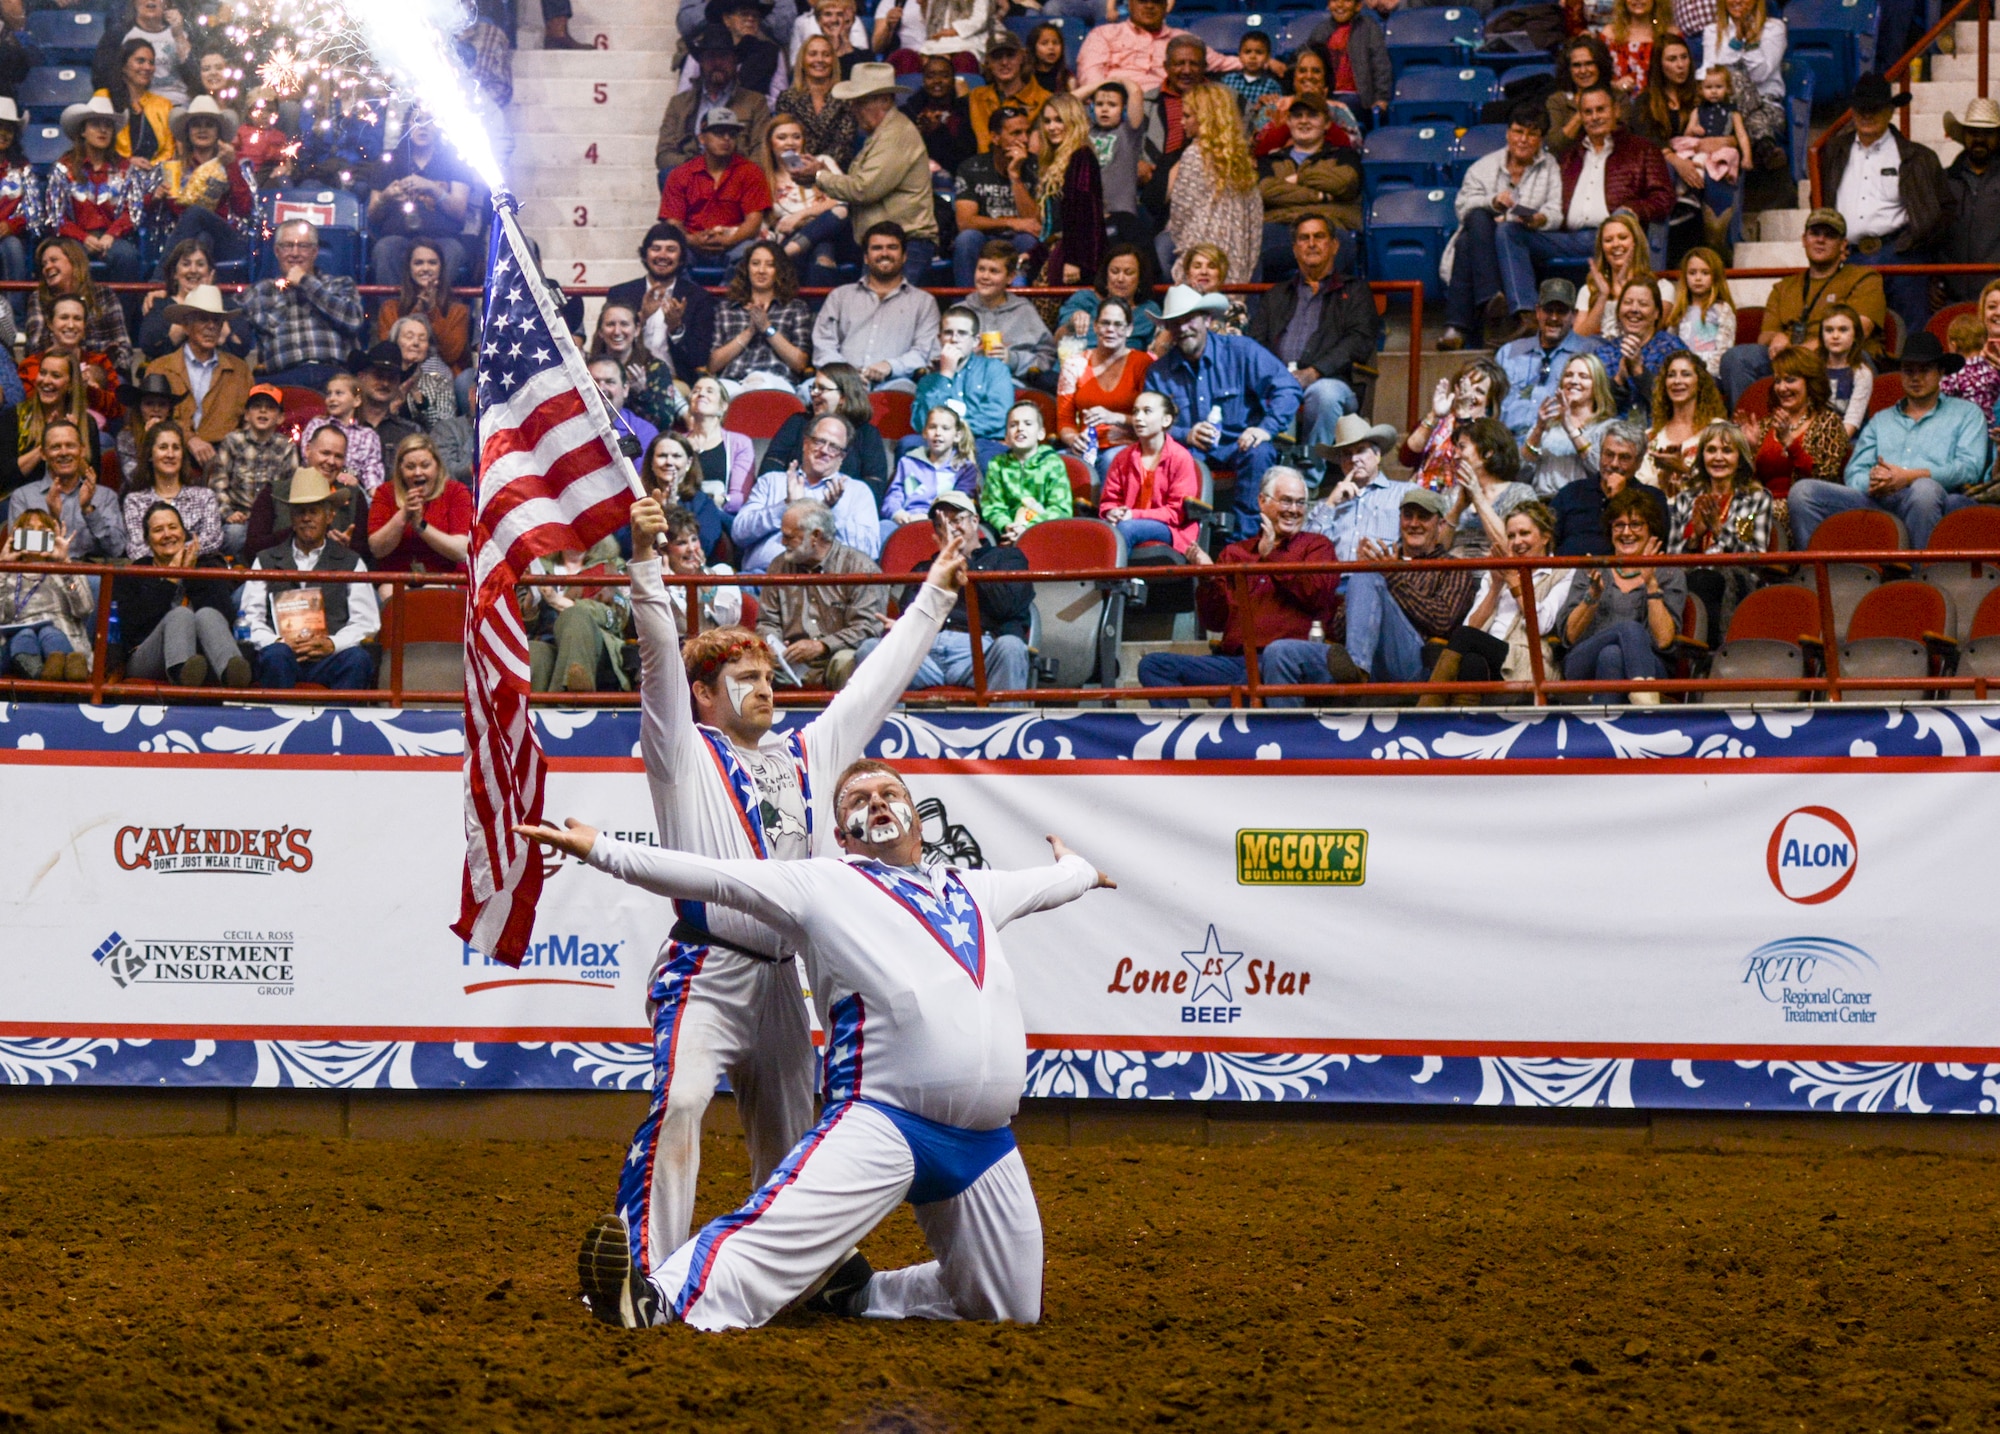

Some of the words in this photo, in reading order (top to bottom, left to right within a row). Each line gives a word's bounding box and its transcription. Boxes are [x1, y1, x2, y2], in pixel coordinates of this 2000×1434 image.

[593, 33, 609, 51] 6
[593, 82, 608, 105] 5
[584, 142, 599, 165] 4
[573, 205, 588, 228] 3
[572, 261, 587, 284] 2
[114, 823, 314, 873] CAVENDER'S
[1781, 838, 1849, 868] ALON
[180, 855, 202, 869] JUST
[205, 855, 230, 868] WEAR
[245, 858, 265, 871] LIVE
[1244, 869, 1304, 880] BUILDING
[1307, 870, 1354, 881] SUPPLY
[223, 931, 254, 941] CECIL
[268, 931, 294, 941] ROSS
[143, 944, 294, 962] INVESTMENT
[462, 934, 620, 967] FerMax
[154, 963, 294, 981] INSURANCE
[580, 969, 620, 979] cotton
[1107, 957, 1188, 994] Lone
[1245, 959, 1311, 996] Star
[1742, 956, 1817, 1000] RCTC
[257, 986, 295, 996] GROUP
[1782, 988, 1831, 1009] Regional
[1832, 988, 1872, 1005] Cancer
[1181, 1006, 1242, 1023] BEEF
[1782, 1006, 1838, 1023] Treatment
[1839, 1006, 1877, 1023] Center
